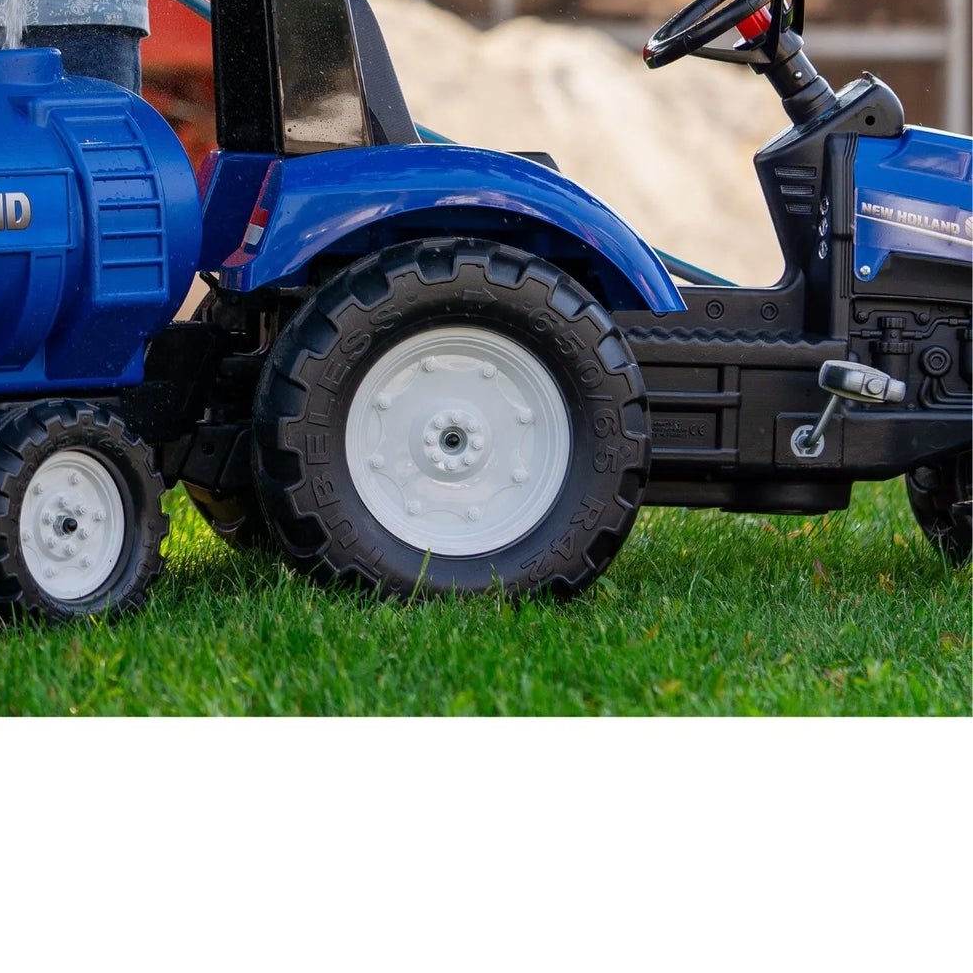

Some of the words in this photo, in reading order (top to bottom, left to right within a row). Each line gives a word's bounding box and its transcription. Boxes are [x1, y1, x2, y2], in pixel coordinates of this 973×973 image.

[861, 202, 894, 218] NEW
[897, 211, 961, 235] HOLLAND
[305, 306, 402, 581] TUBELESS
[520, 493, 607, 583] R42
